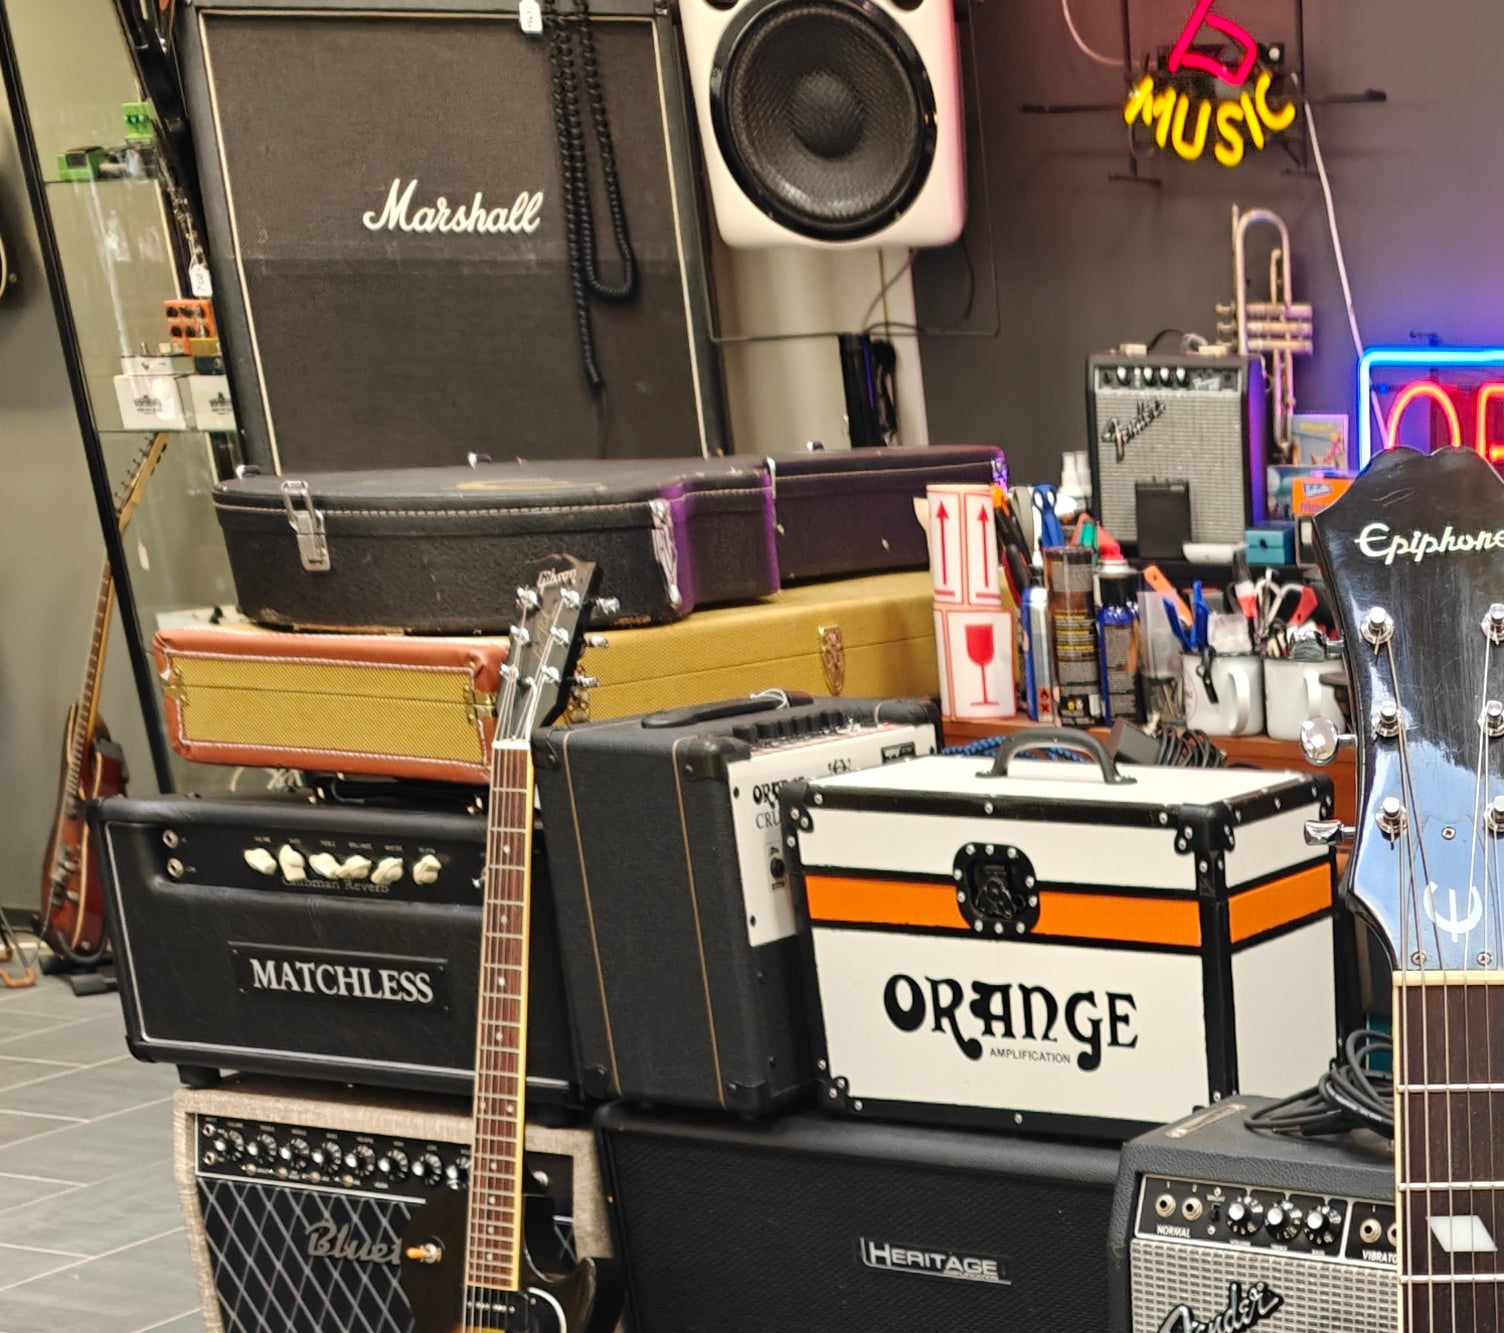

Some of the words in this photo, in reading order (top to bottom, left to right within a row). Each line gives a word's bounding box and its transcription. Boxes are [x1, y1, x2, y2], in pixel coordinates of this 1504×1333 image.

[1123, 70, 1295, 168] MUSIC
[362, 178, 543, 233] Marshall
[1101, 396, 1167, 464] Fender
[250, 958, 434, 1003] MATCHLESS
[883, 974, 1138, 1072] ORANGE
[989, 1047, 1071, 1064] AMPLIFICATION
[1156, 1224, 1191, 1238] NORMAL
[869, 1241, 999, 1276] HERITAGE
